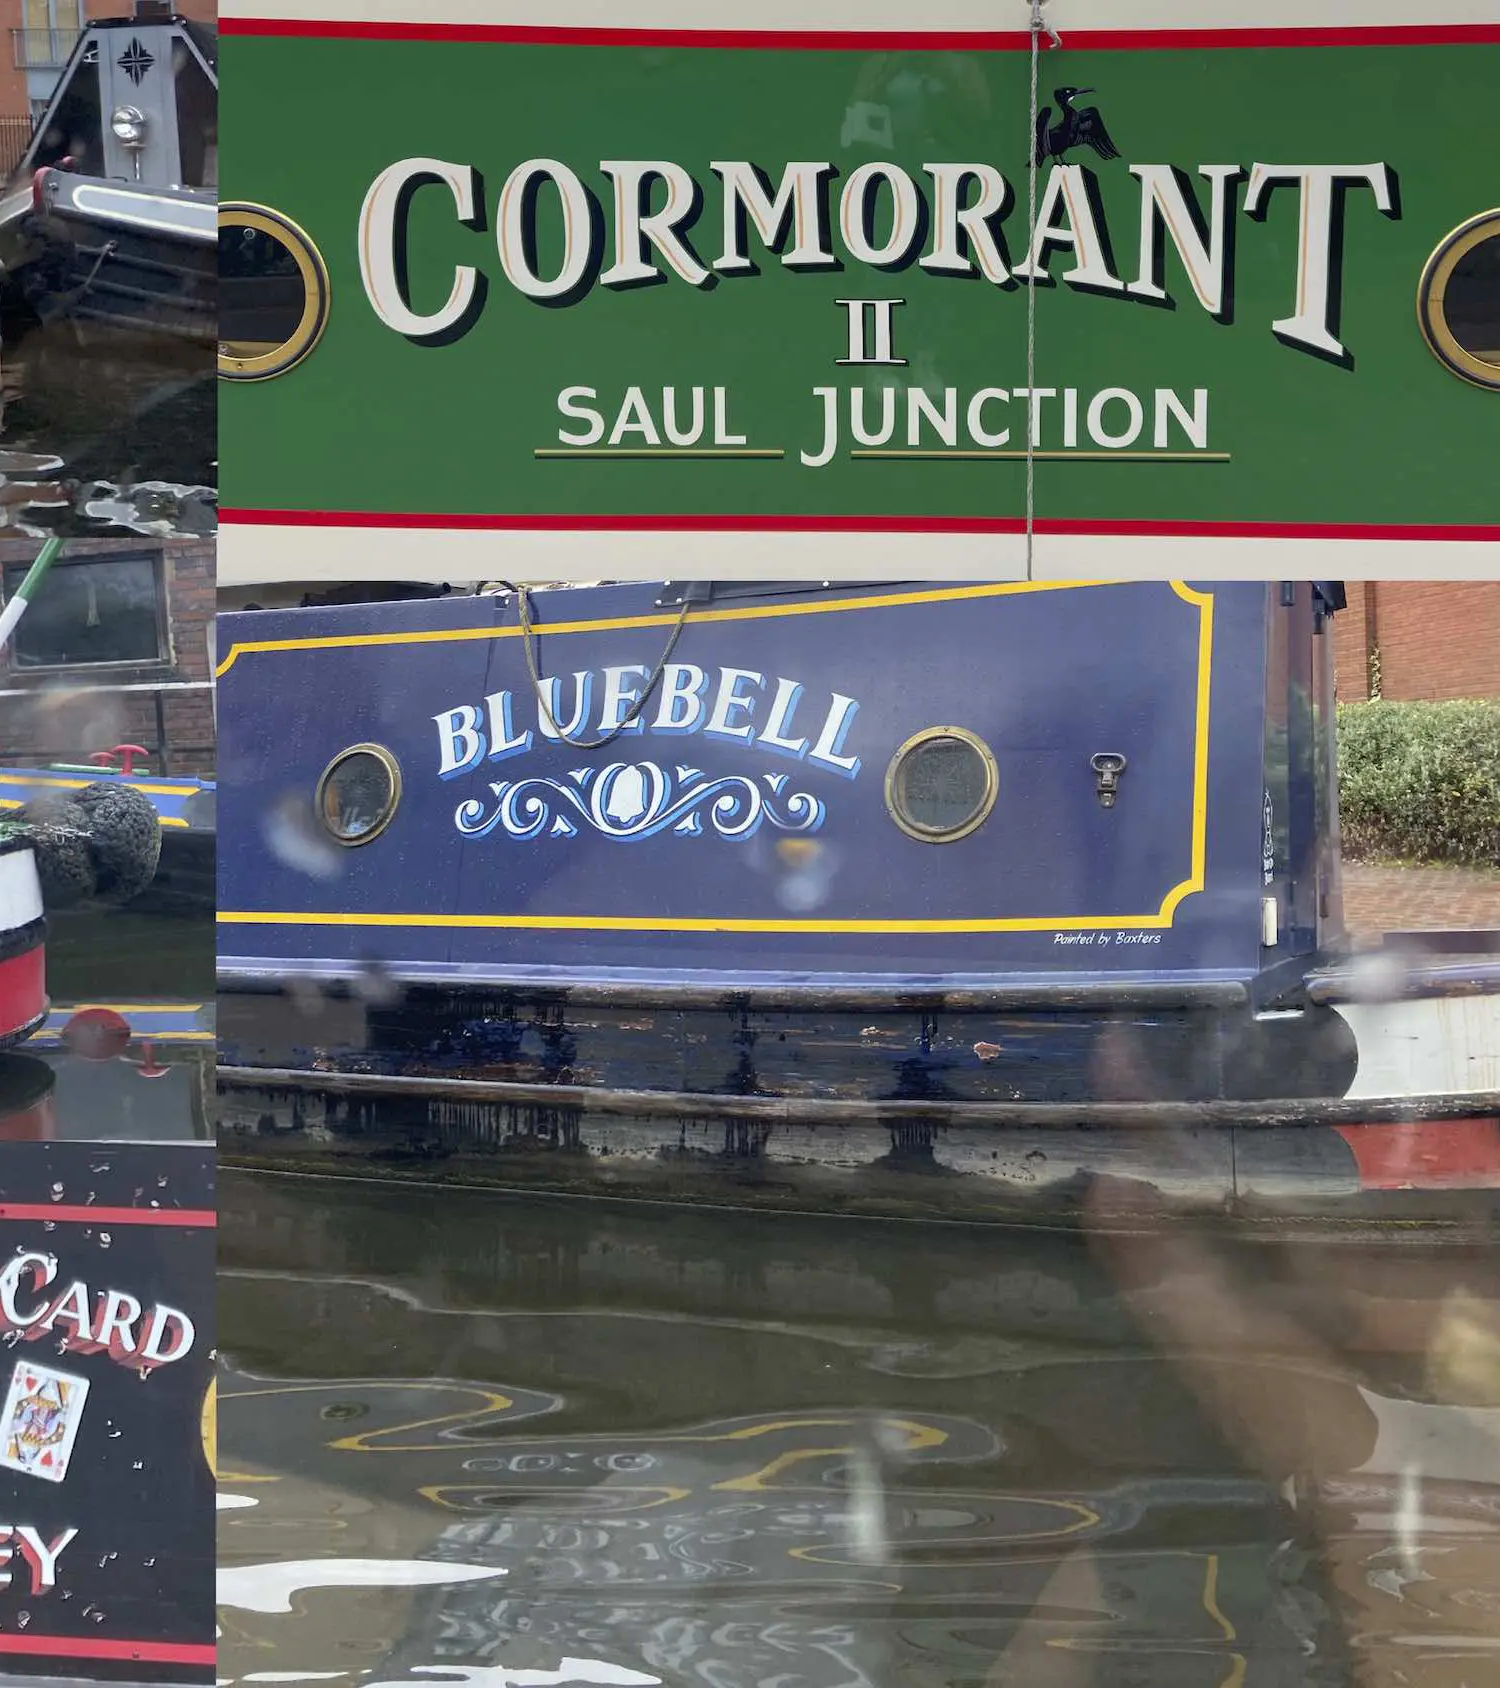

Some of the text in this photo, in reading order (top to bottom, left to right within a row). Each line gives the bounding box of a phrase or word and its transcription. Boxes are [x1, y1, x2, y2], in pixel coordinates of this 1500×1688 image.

[357, 157, 1392, 358] CORMORANT
[835, 298, 906, 365] II
[557, 386, 1209, 467] SAUL JUNCTION
[434, 662, 860, 780] BLUEBELL
[1053, 930, 1162, 948] Painted by Baxters
